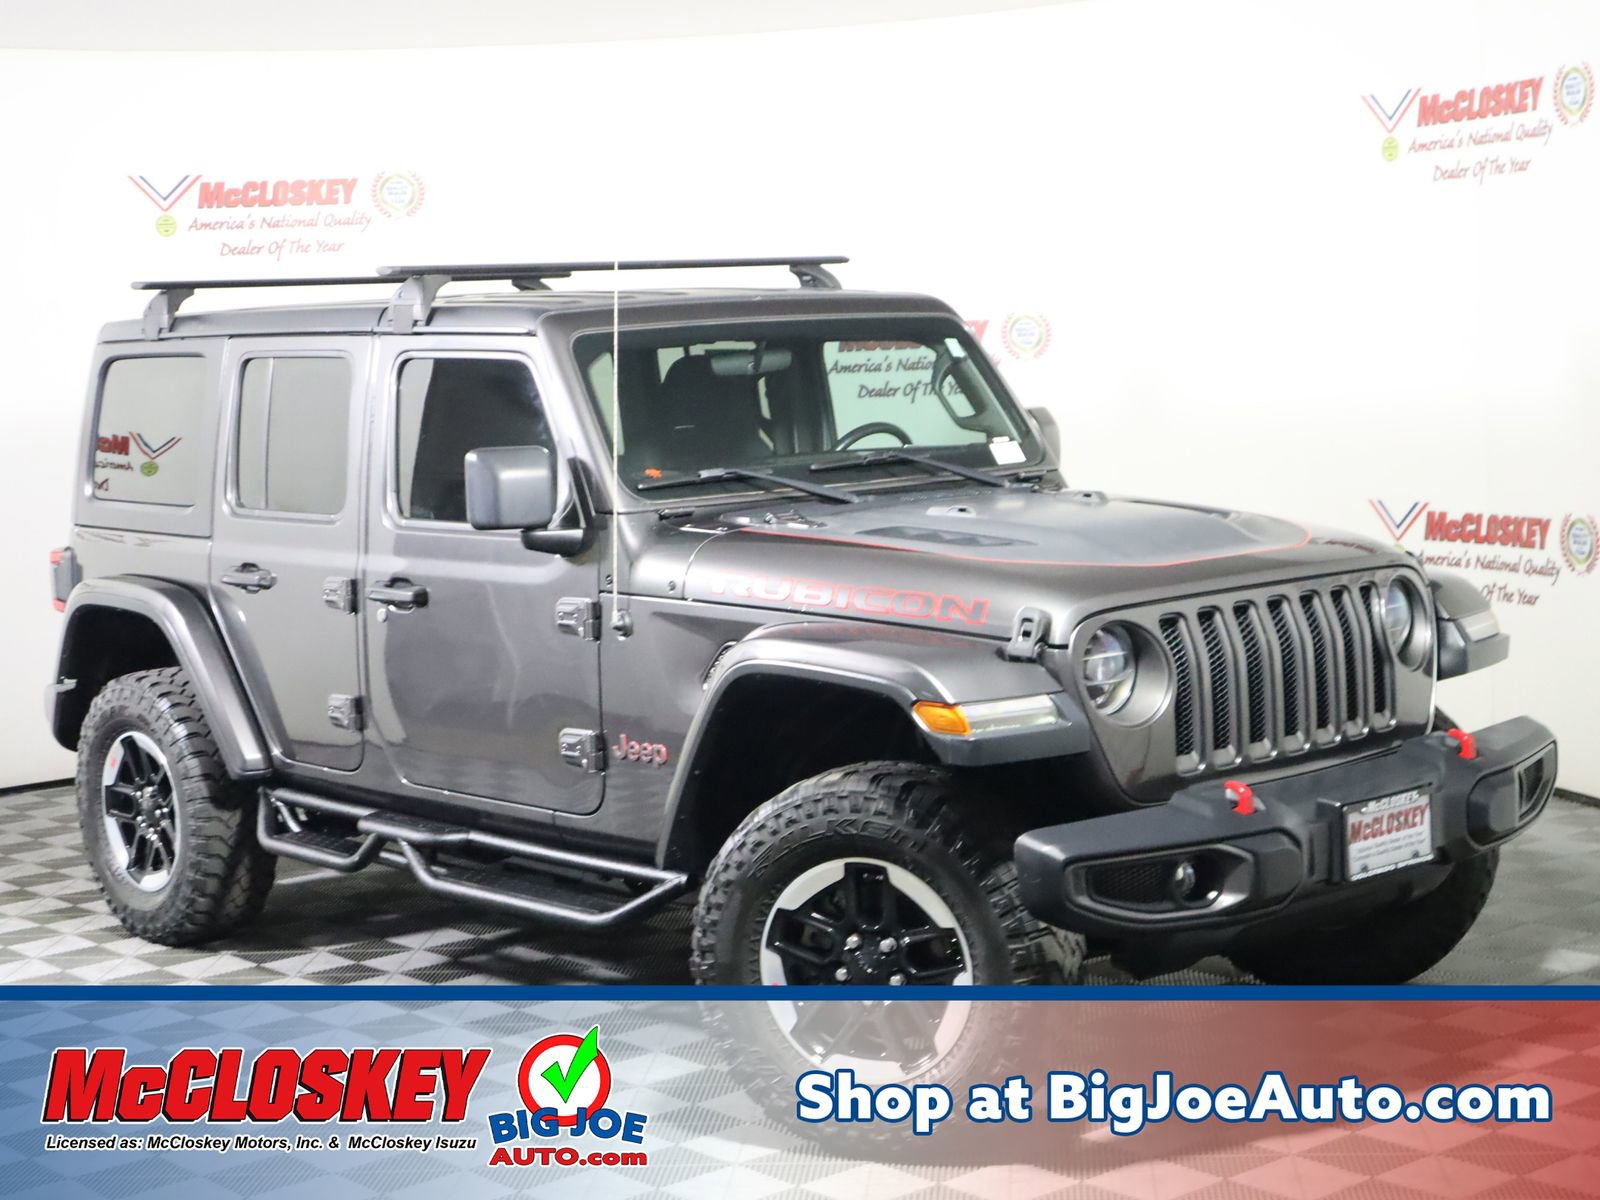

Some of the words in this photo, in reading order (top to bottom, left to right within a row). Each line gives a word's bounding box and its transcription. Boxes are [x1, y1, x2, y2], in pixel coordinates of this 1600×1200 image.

[1417, 77, 1544, 127] McCLOSKEY
[1408, 129, 1463, 153] America's
[1467, 121, 1514, 146] National
[1515, 117, 1553, 146] Quality
[1433, 160, 1470, 181] Dealer
[1472, 157, 1489, 184] Of
[1488, 155, 1506, 175] The
[1509, 157, 1532, 173] Year
[198, 178, 358, 209] McCLOSKEY
[188, 214, 255, 231] America's
[260, 211, 319, 229] National
[323, 209, 372, 232] Quality
[220, 239, 265, 256] Dealer
[267, 238, 287, 261] Of
[288, 238, 311, 254] The
[316, 239, 344, 253] Year
[828, 355, 893, 375] America's
[896, 356, 933, 371] Natio
[858, 380, 901, 398] Dealer
[903, 380, 922, 404] Of
[1424, 511, 1551, 549] McCLOSKEY
[1475, 554, 1522, 574] National
[1523, 559, 1561, 586] Quality
[709, 570, 989, 625] RUBICON
[1496, 583, 1515, 602] The
[1517, 587, 1540, 605] Year
[612, 733, 668, 769] Jeep
[1350, 803, 1430, 844] McCLOSKEY
